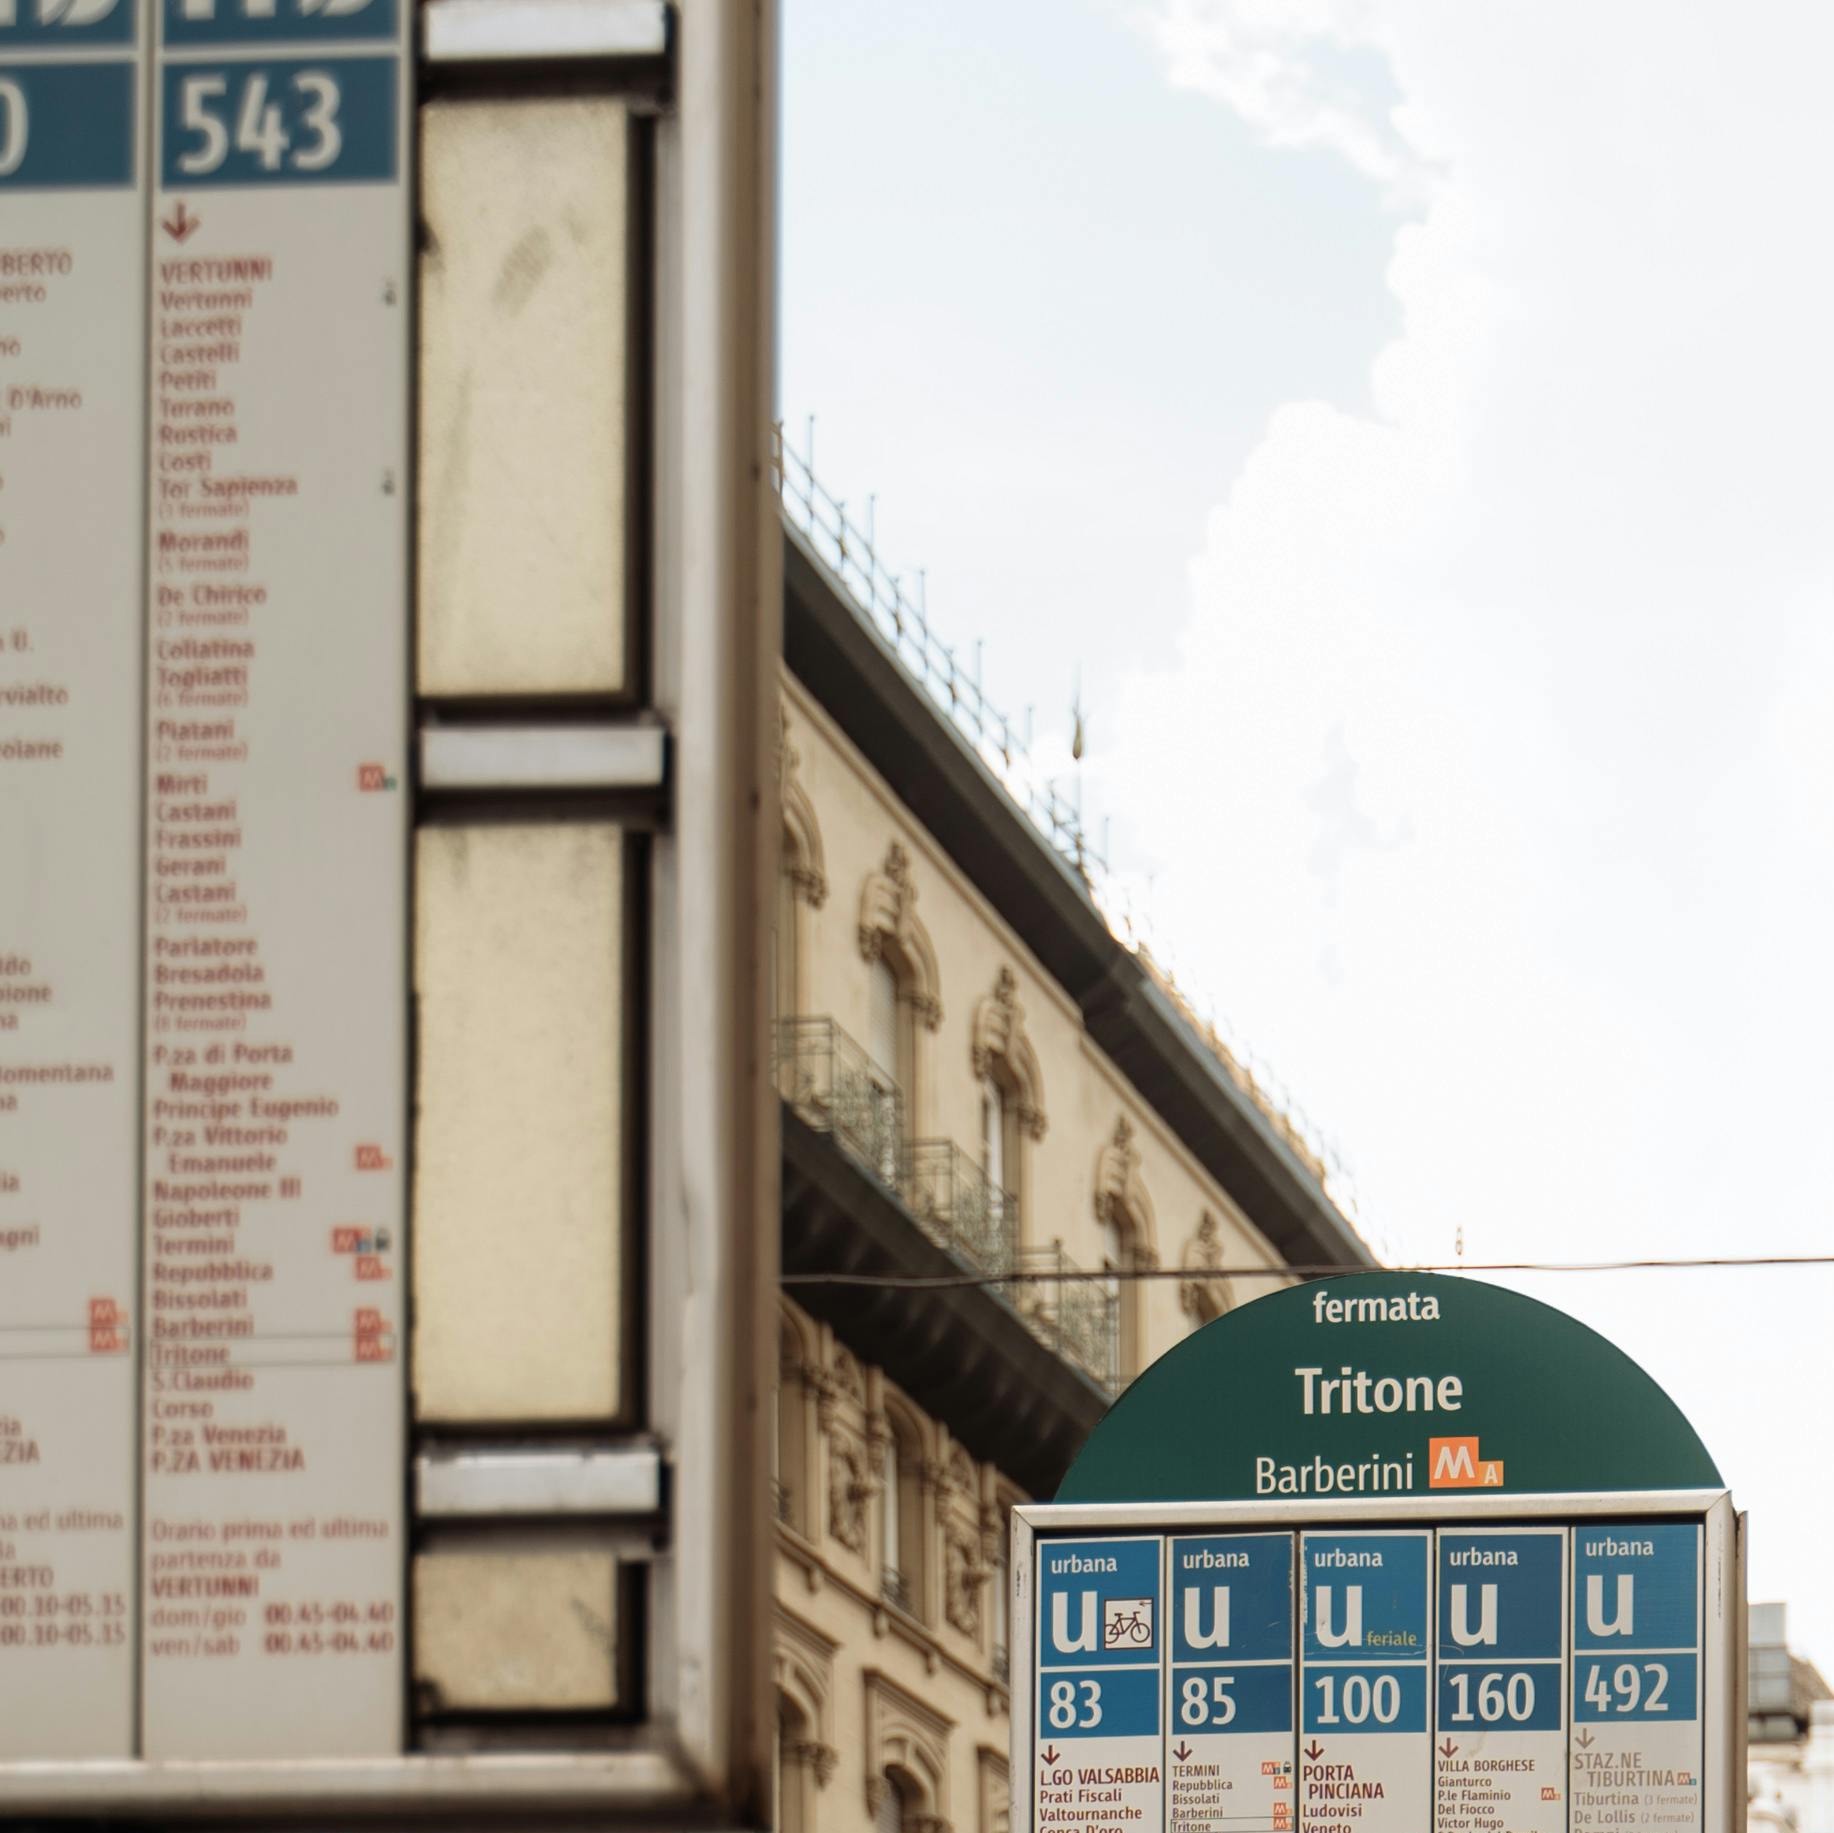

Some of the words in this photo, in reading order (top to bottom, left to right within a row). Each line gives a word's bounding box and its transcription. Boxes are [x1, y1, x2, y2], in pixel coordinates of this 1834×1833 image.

[177, 72, 342, 173] 543
[1312, 1291, 1441, 1323] fermata
[1294, 1366, 1463, 1415] Tritone
[1256, 1452, 1413, 1494] Barberini
[1433, 1445, 1476, 1480] M
[1450, 1546, 1519, 1566] urbana
[1585, 1536, 1654, 1557] urbana
[1051, 1553, 1118, 1574] urbana
[1183, 1549, 1250, 1569] urbana
[1314, 1547, 1384, 1568] urbana
[1450, 1584, 1499, 1645] u
[1586, 1575, 1635, 1636] u
[1052, 1590, 1098, 1653] u
[1183, 1587, 1230, 1649] u
[1316, 1586, 1364, 1647] u
[1366, 1630, 1417, 1647] feriale
[1449, 1672, 1535, 1722] 160
[1584, 1663, 1669, 1712] 492
[1049, 1679, 1103, 1729] 83
[1181, 1676, 1236, 1726] 85
[1315, 1674, 1401, 1724] 100
[1172, 1764, 1220, 1778] TERMINI
[1437, 1760, 1470, 1773] VILLA
[1473, 1759, 1535, 1772] BORGHESE
[1573, 1752, 1642, 1770] STAZ.NE
[1077, 1766, 1160, 1785] VALSABBIA
[1303, 1764, 1355, 1782] PORTA
[1586, 1769, 1675, 1788] TIBURTINA
[1040, 1789, 1073, 1804] Prati
[1078, 1788, 1122, 1803] Fiscali
[1172, 1779, 1233, 1794] Repubblica
[1308, 1782, 1385, 1800] PINCIANA
[1039, 1806, 1143, 1822] Valtournanche
[1303, 1803, 1362, 1818] Ludovisi
[1437, 1817, 1471, 1829] Victor
[1474, 1817, 1504, 1831] Hugo
